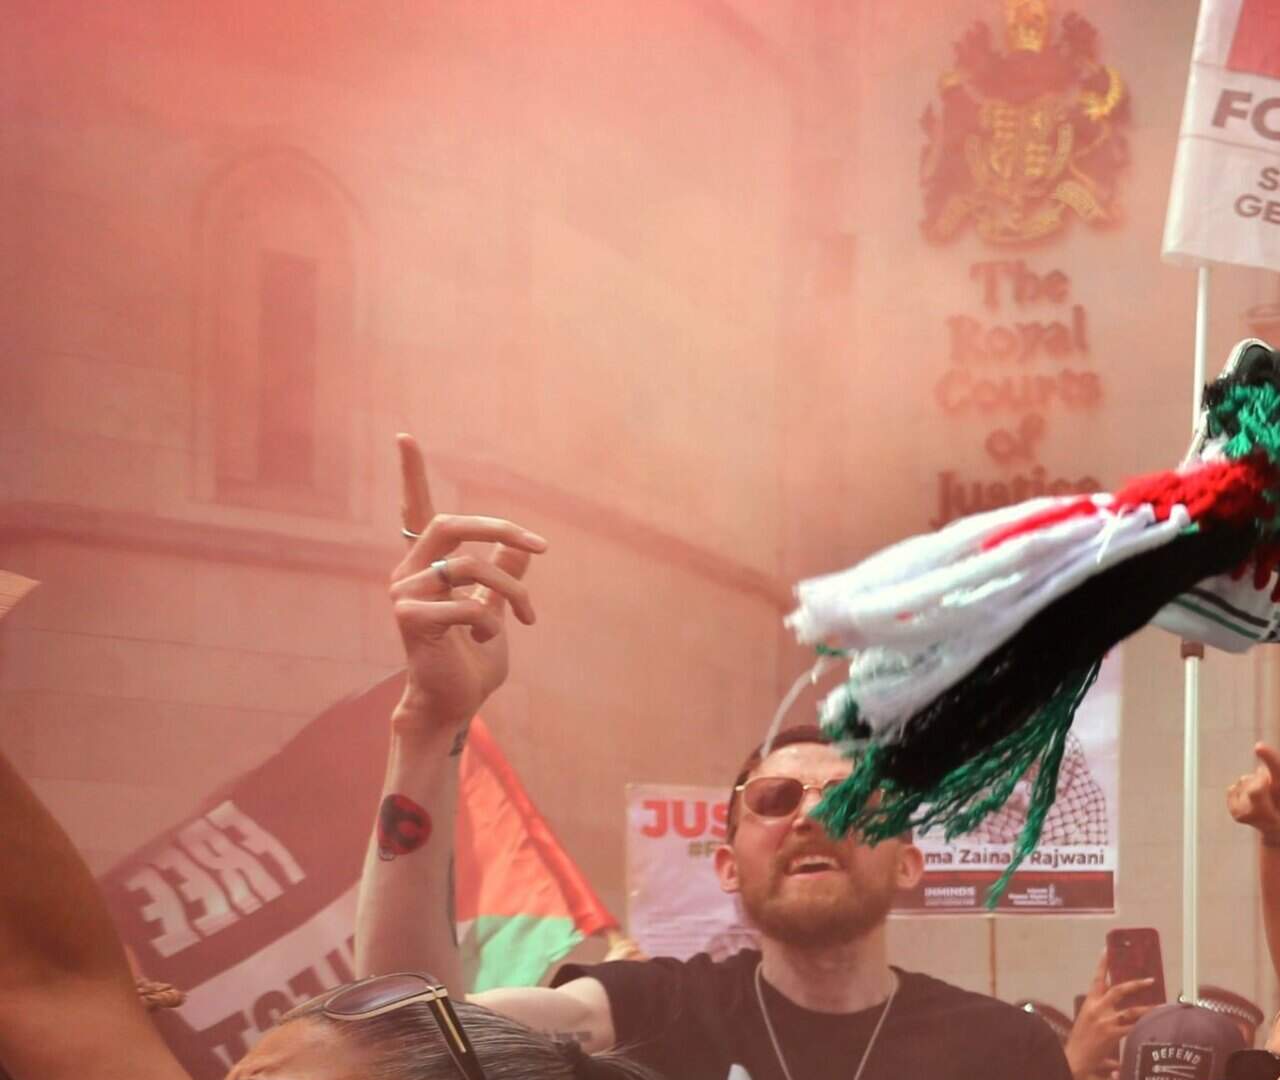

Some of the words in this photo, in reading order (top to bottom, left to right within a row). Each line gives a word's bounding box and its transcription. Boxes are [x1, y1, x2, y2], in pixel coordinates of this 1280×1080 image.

[640, 800, 729, 838] JUS
[960, 850, 1011, 864] Zaina
[1030, 849, 1105, 868] Rajwani
[1151, 1047, 1201, 1065] DEFEND
